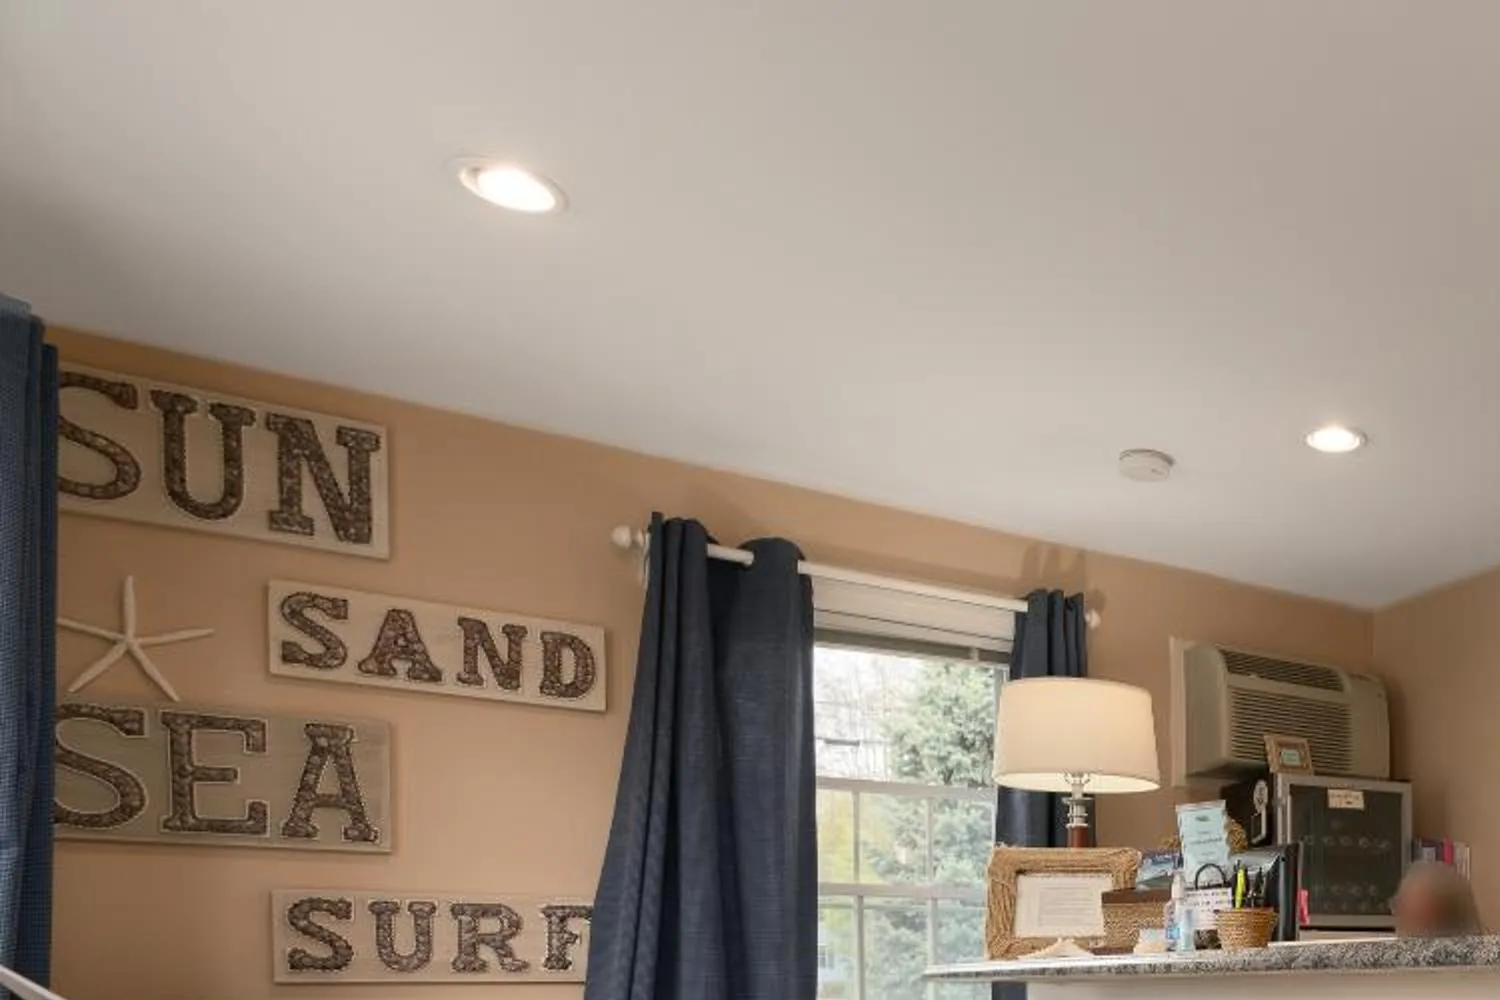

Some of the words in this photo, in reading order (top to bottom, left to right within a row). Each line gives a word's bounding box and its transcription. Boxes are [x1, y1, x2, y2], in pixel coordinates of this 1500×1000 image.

[57, 369, 381, 545] SUN
[279, 590, 597, 698] SAND
[52, 702, 380, 844] SEA
[286, 895, 593, 973] SURF
